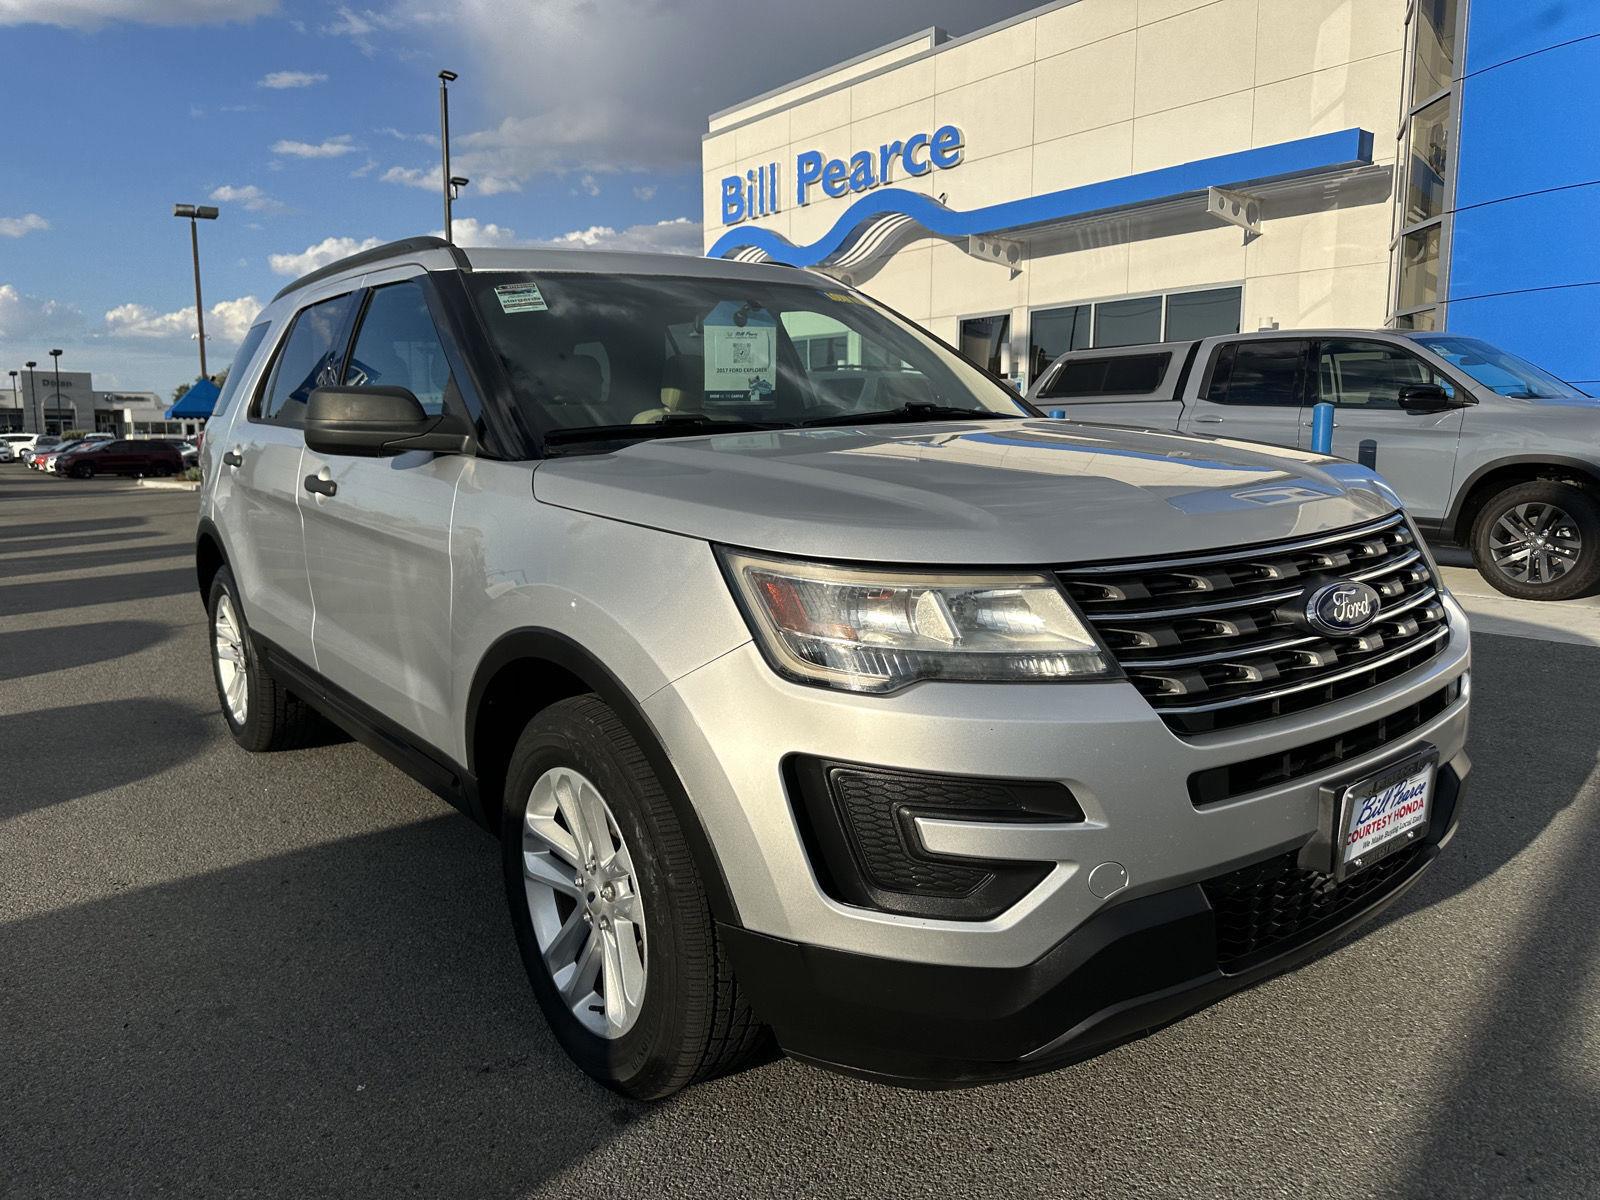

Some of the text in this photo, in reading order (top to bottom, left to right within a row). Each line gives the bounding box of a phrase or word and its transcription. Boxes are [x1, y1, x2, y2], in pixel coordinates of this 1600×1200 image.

[722, 125, 964, 225] Bill Pearce
[42, 379, 72, 387] Doan
[1333, 589, 1371, 622] Ford
[1346, 797, 1424, 845] COURTESY HONDA
[1356, 780, 1426, 826] Bill Pearce
